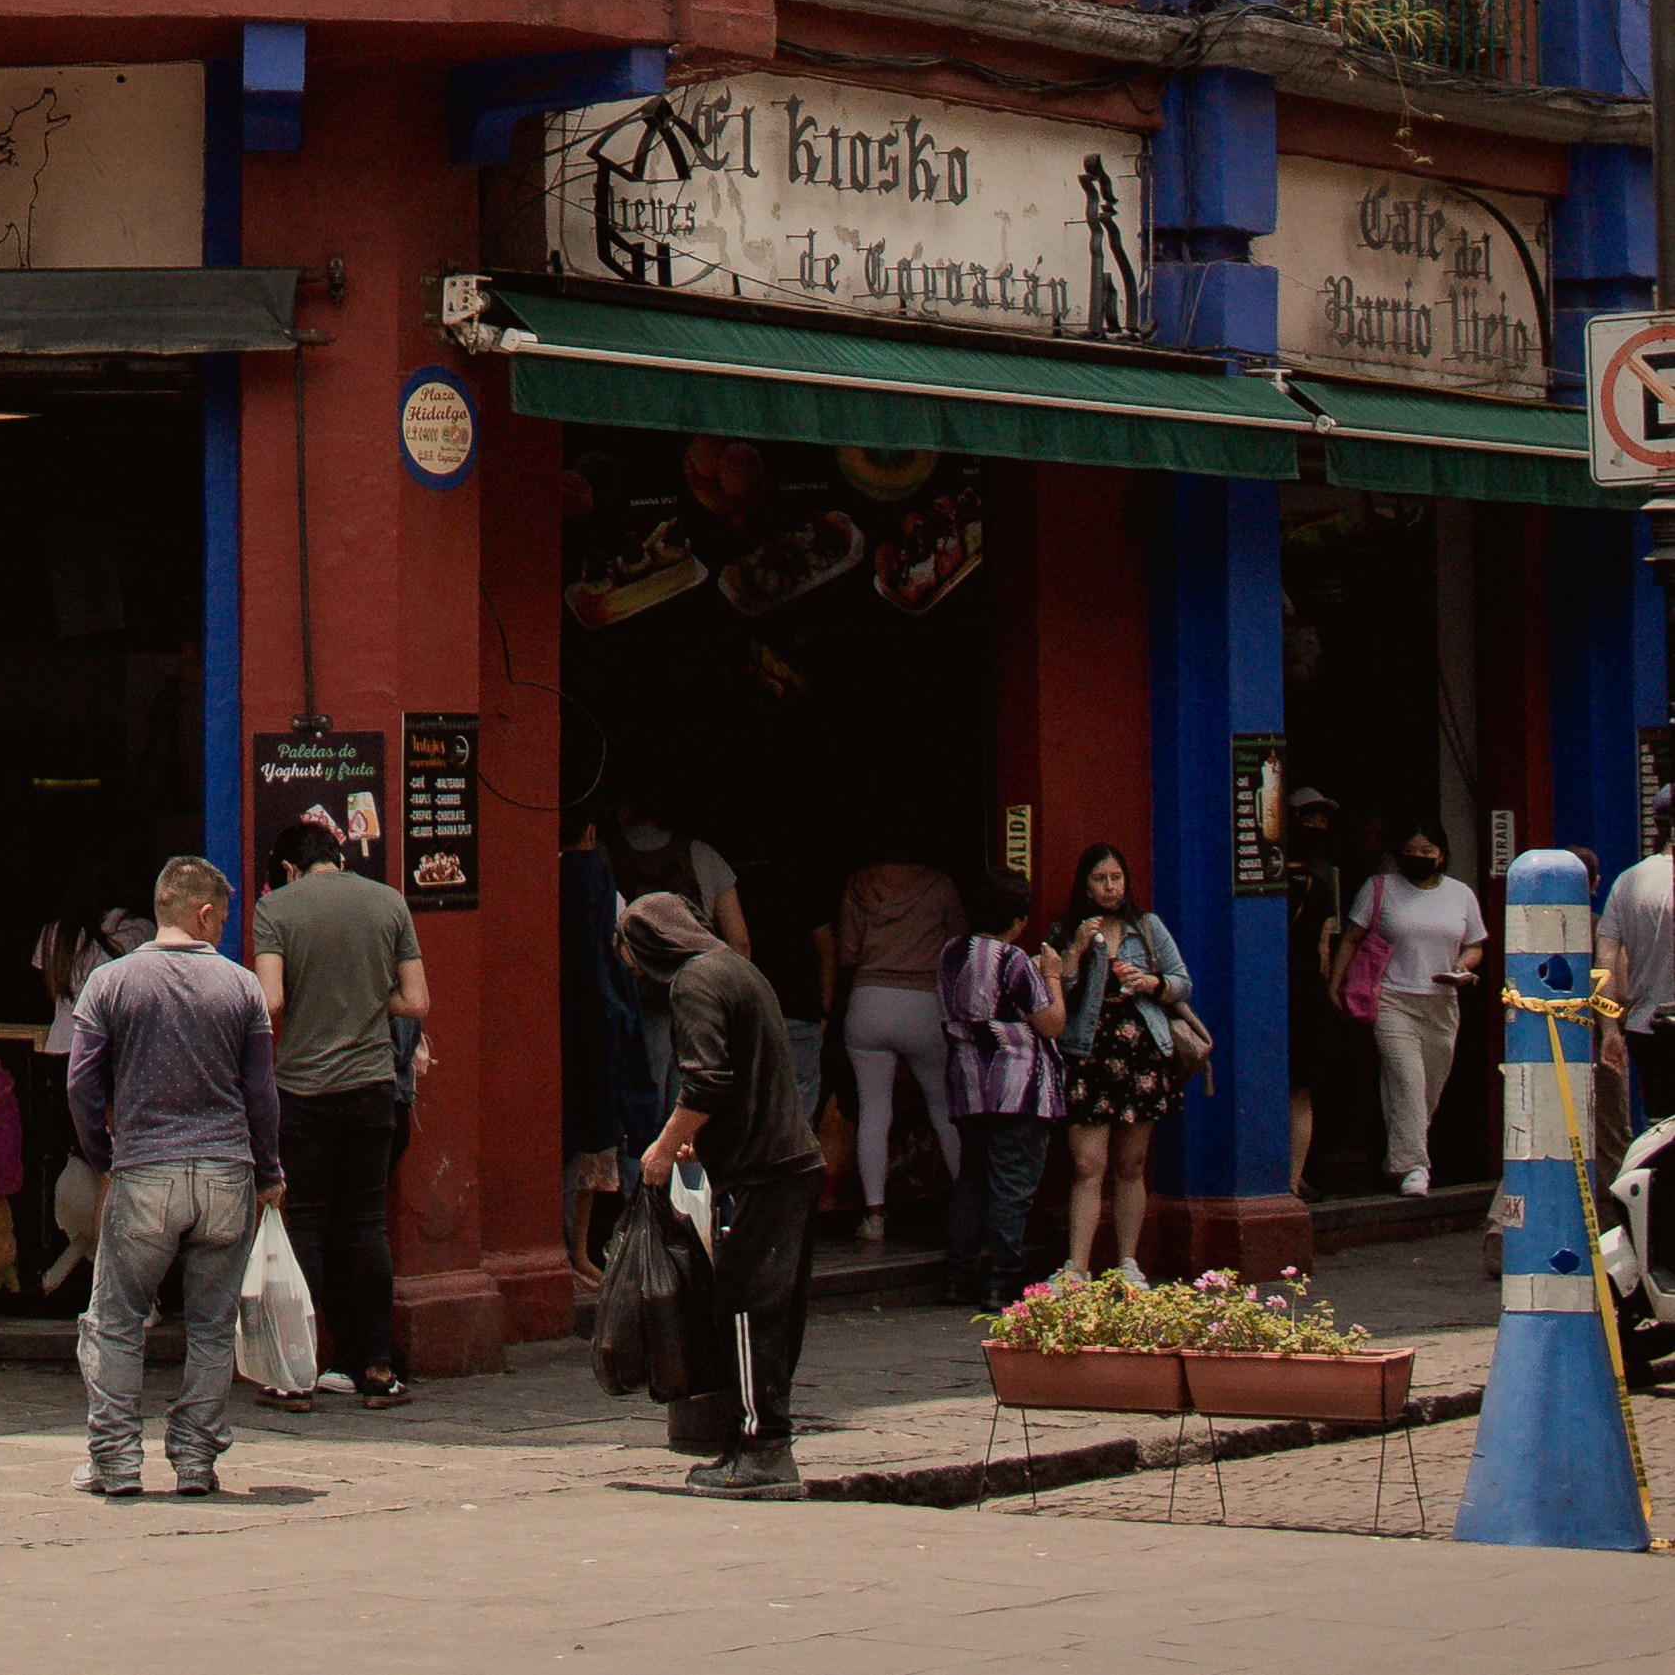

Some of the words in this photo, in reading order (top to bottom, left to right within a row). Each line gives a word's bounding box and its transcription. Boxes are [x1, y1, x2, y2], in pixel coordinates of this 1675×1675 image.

[693, 84, 761, 178] El
[797, 227, 841, 294] de
[861, 236, 1071, 319] Coyoacán
[1453, 225, 1493, 284] del
[1324, 275, 1432, 358] Barrio
[406, 405, 469, 424] Hidalgo
[420, 387, 456, 402] Plaza
[260, 762, 324, 783] Yoghurt
[324, 764, 335, 782] y
[337, 762, 375, 781] fruta
[277, 743, 336, 759] Paletas
[338, 743, 357, 758] de
[1009, 807, 1027, 872] ALIDA
[1495, 811, 1508, 873] ENTRADA
